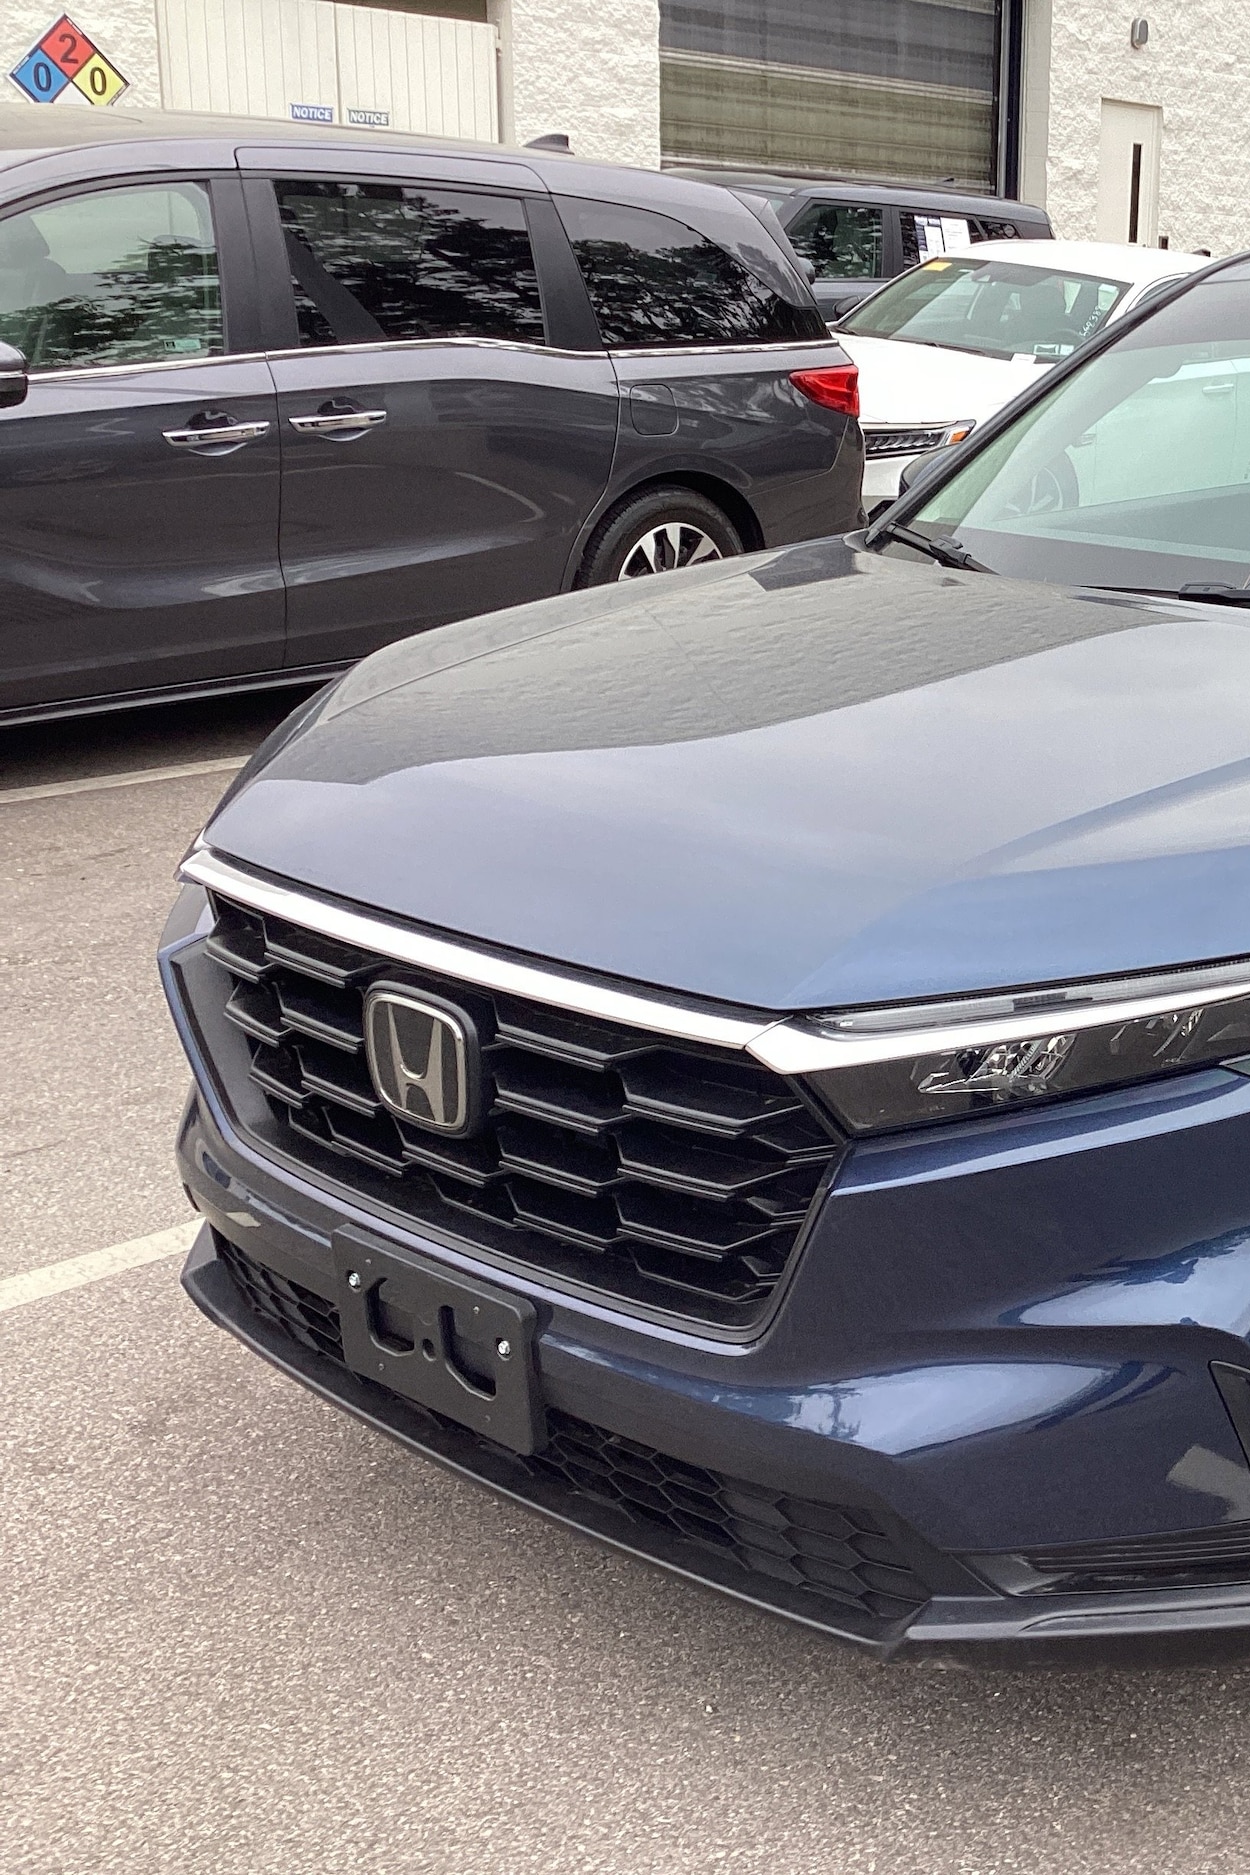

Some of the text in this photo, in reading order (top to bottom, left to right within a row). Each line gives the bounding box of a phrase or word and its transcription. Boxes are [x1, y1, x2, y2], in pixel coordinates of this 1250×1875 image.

[59, 33, 79, 64] 2
[33, 62, 52, 92] 0
[90, 66, 107, 96] 0
[293, 105, 332, 121] NOTICE
[350, 110, 388, 125] NOTICE
